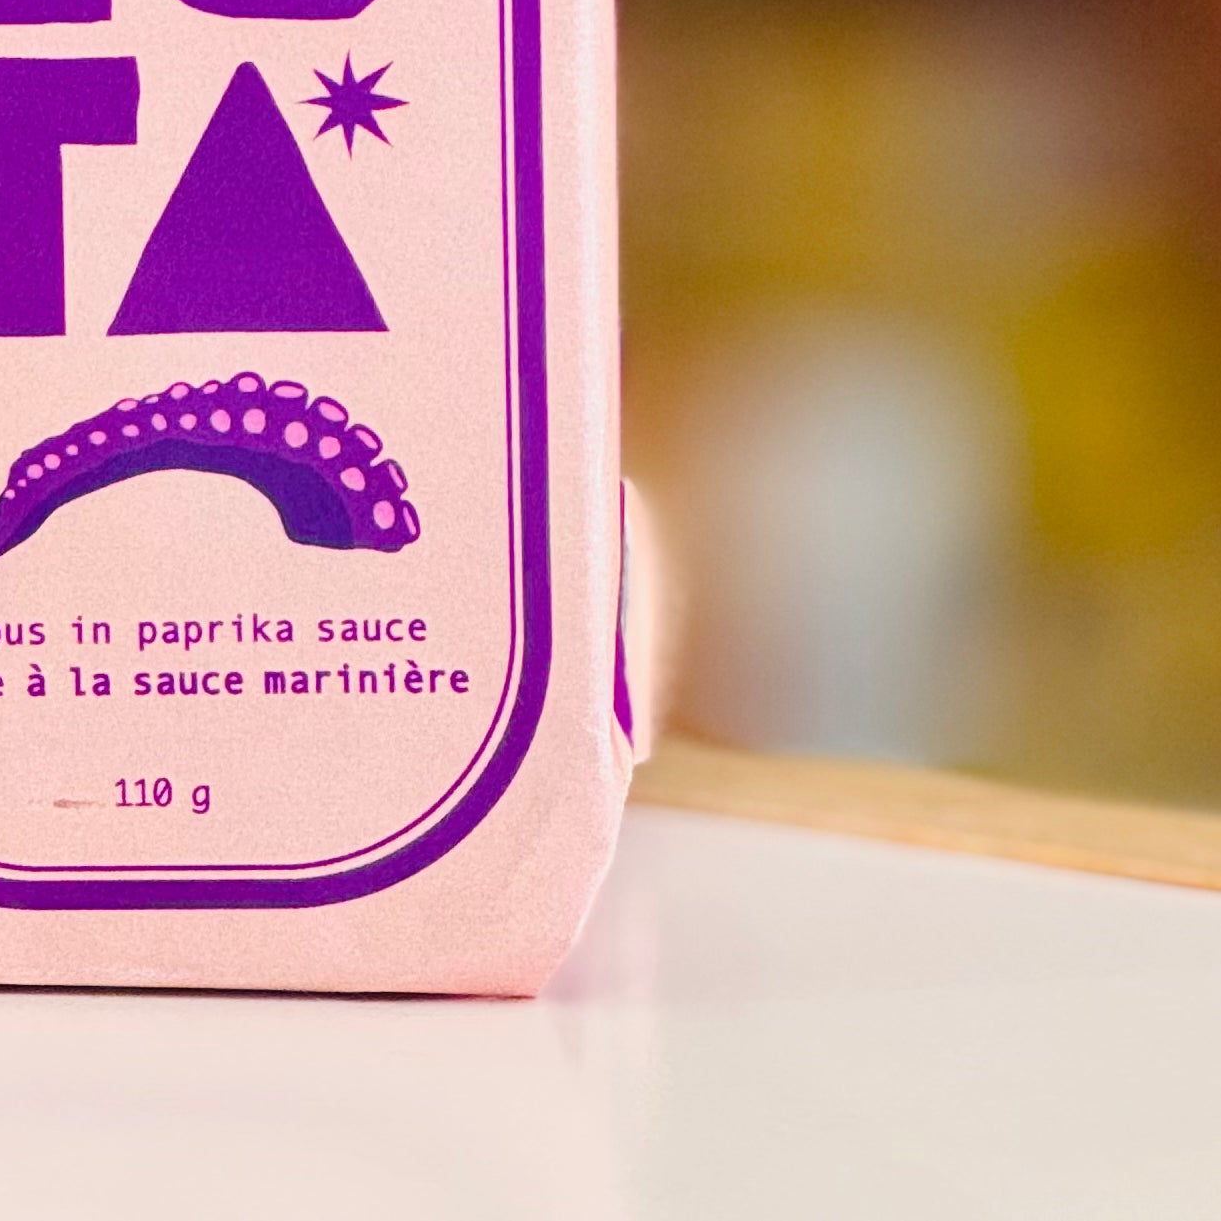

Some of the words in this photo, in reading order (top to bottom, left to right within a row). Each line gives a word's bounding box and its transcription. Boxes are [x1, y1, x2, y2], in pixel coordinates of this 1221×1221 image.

[71, 615, 111, 645] in
[138, 613, 294, 651] paprika
[317, 618, 427, 643] sauce
[26, 663, 47, 698] à
[69, 666, 111, 697] la
[133, 671, 244, 696] sauce
[263, 659, 470, 695] marinière
[115, 777, 173, 808] 110
[191, 784, 211, 815] g
